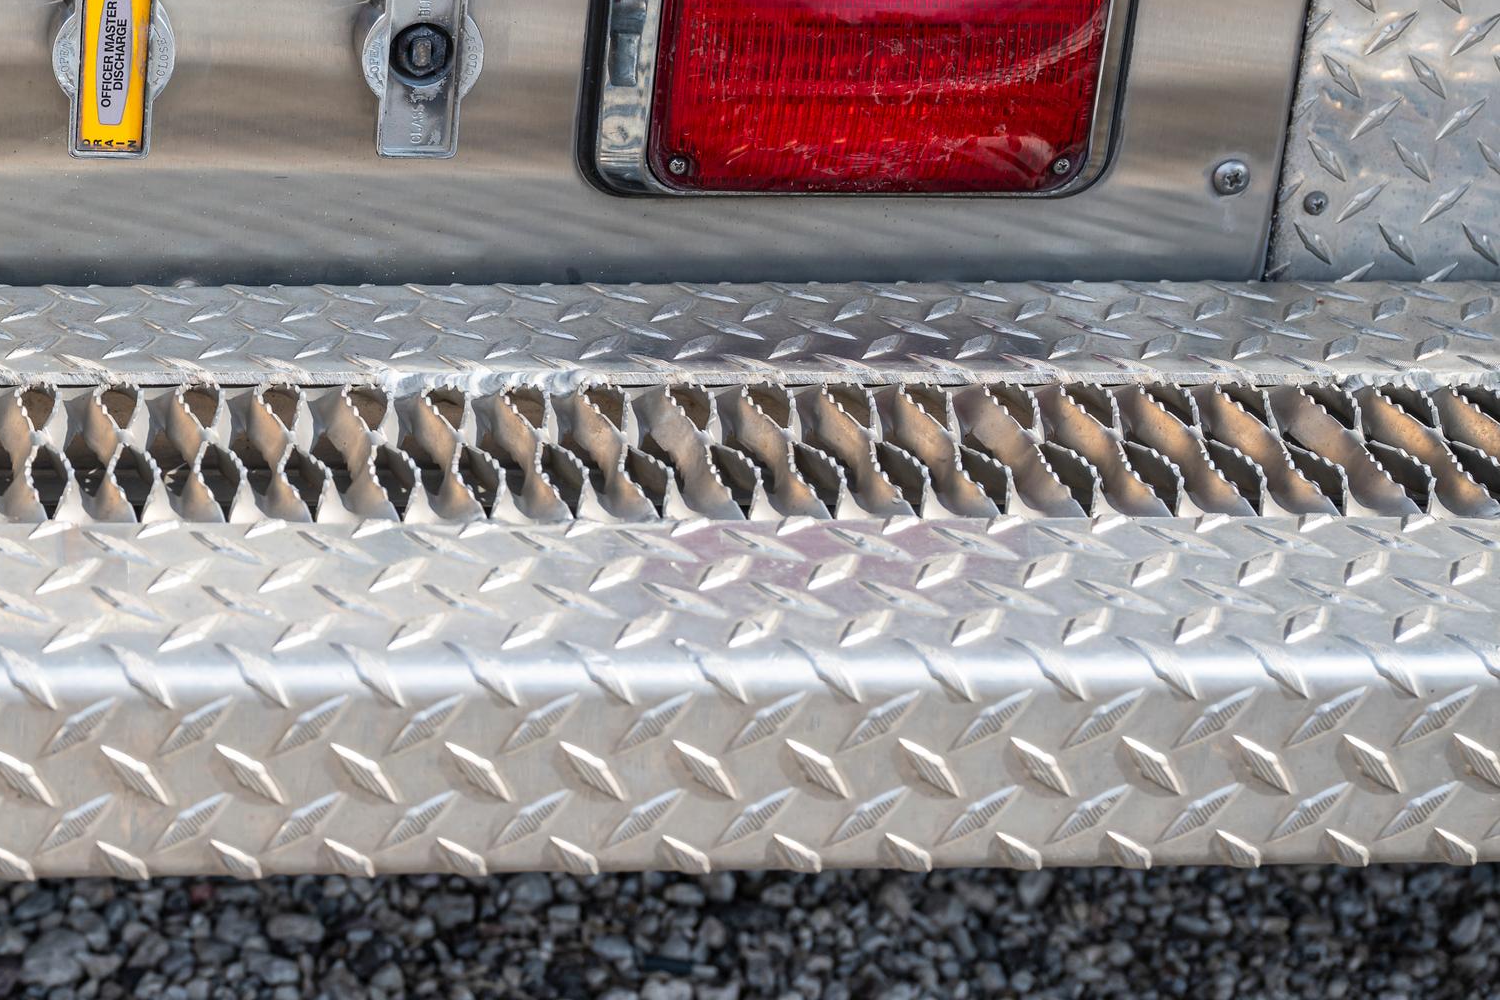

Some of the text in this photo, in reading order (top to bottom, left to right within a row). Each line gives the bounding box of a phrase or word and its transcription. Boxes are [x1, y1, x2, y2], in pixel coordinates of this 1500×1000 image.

[59, 40, 71, 73] OPEN
[101, 0, 118, 108] OFFICER MASTER
[113, 19, 127, 91] DISCHARGE
[155, 37, 168, 77] CLOSE
[369, 40, 381, 73] OPEN
[465, 37, 478, 76] CLOSE
[83, 138, 137, 148] DRAIN
